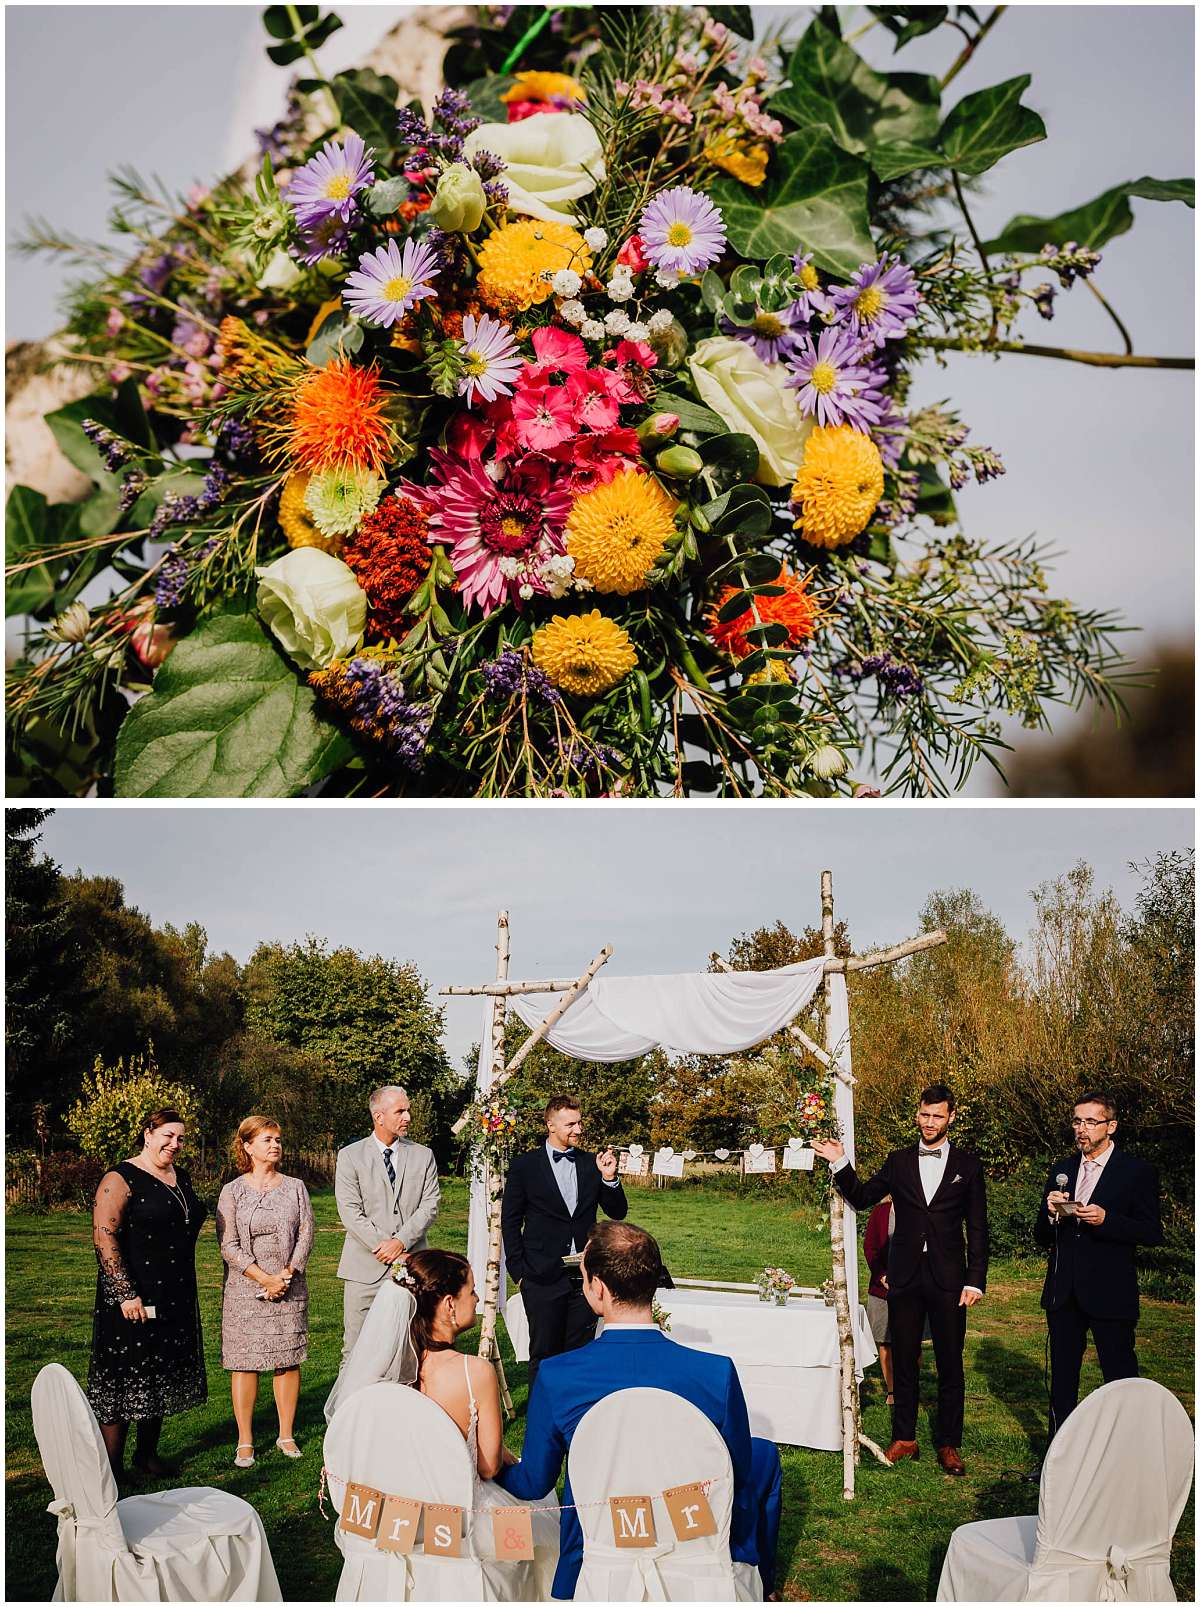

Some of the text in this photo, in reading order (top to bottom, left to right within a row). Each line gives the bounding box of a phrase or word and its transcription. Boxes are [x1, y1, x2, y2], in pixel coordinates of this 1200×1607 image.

[347, 1494, 700, 1550] Mrs & Mr
